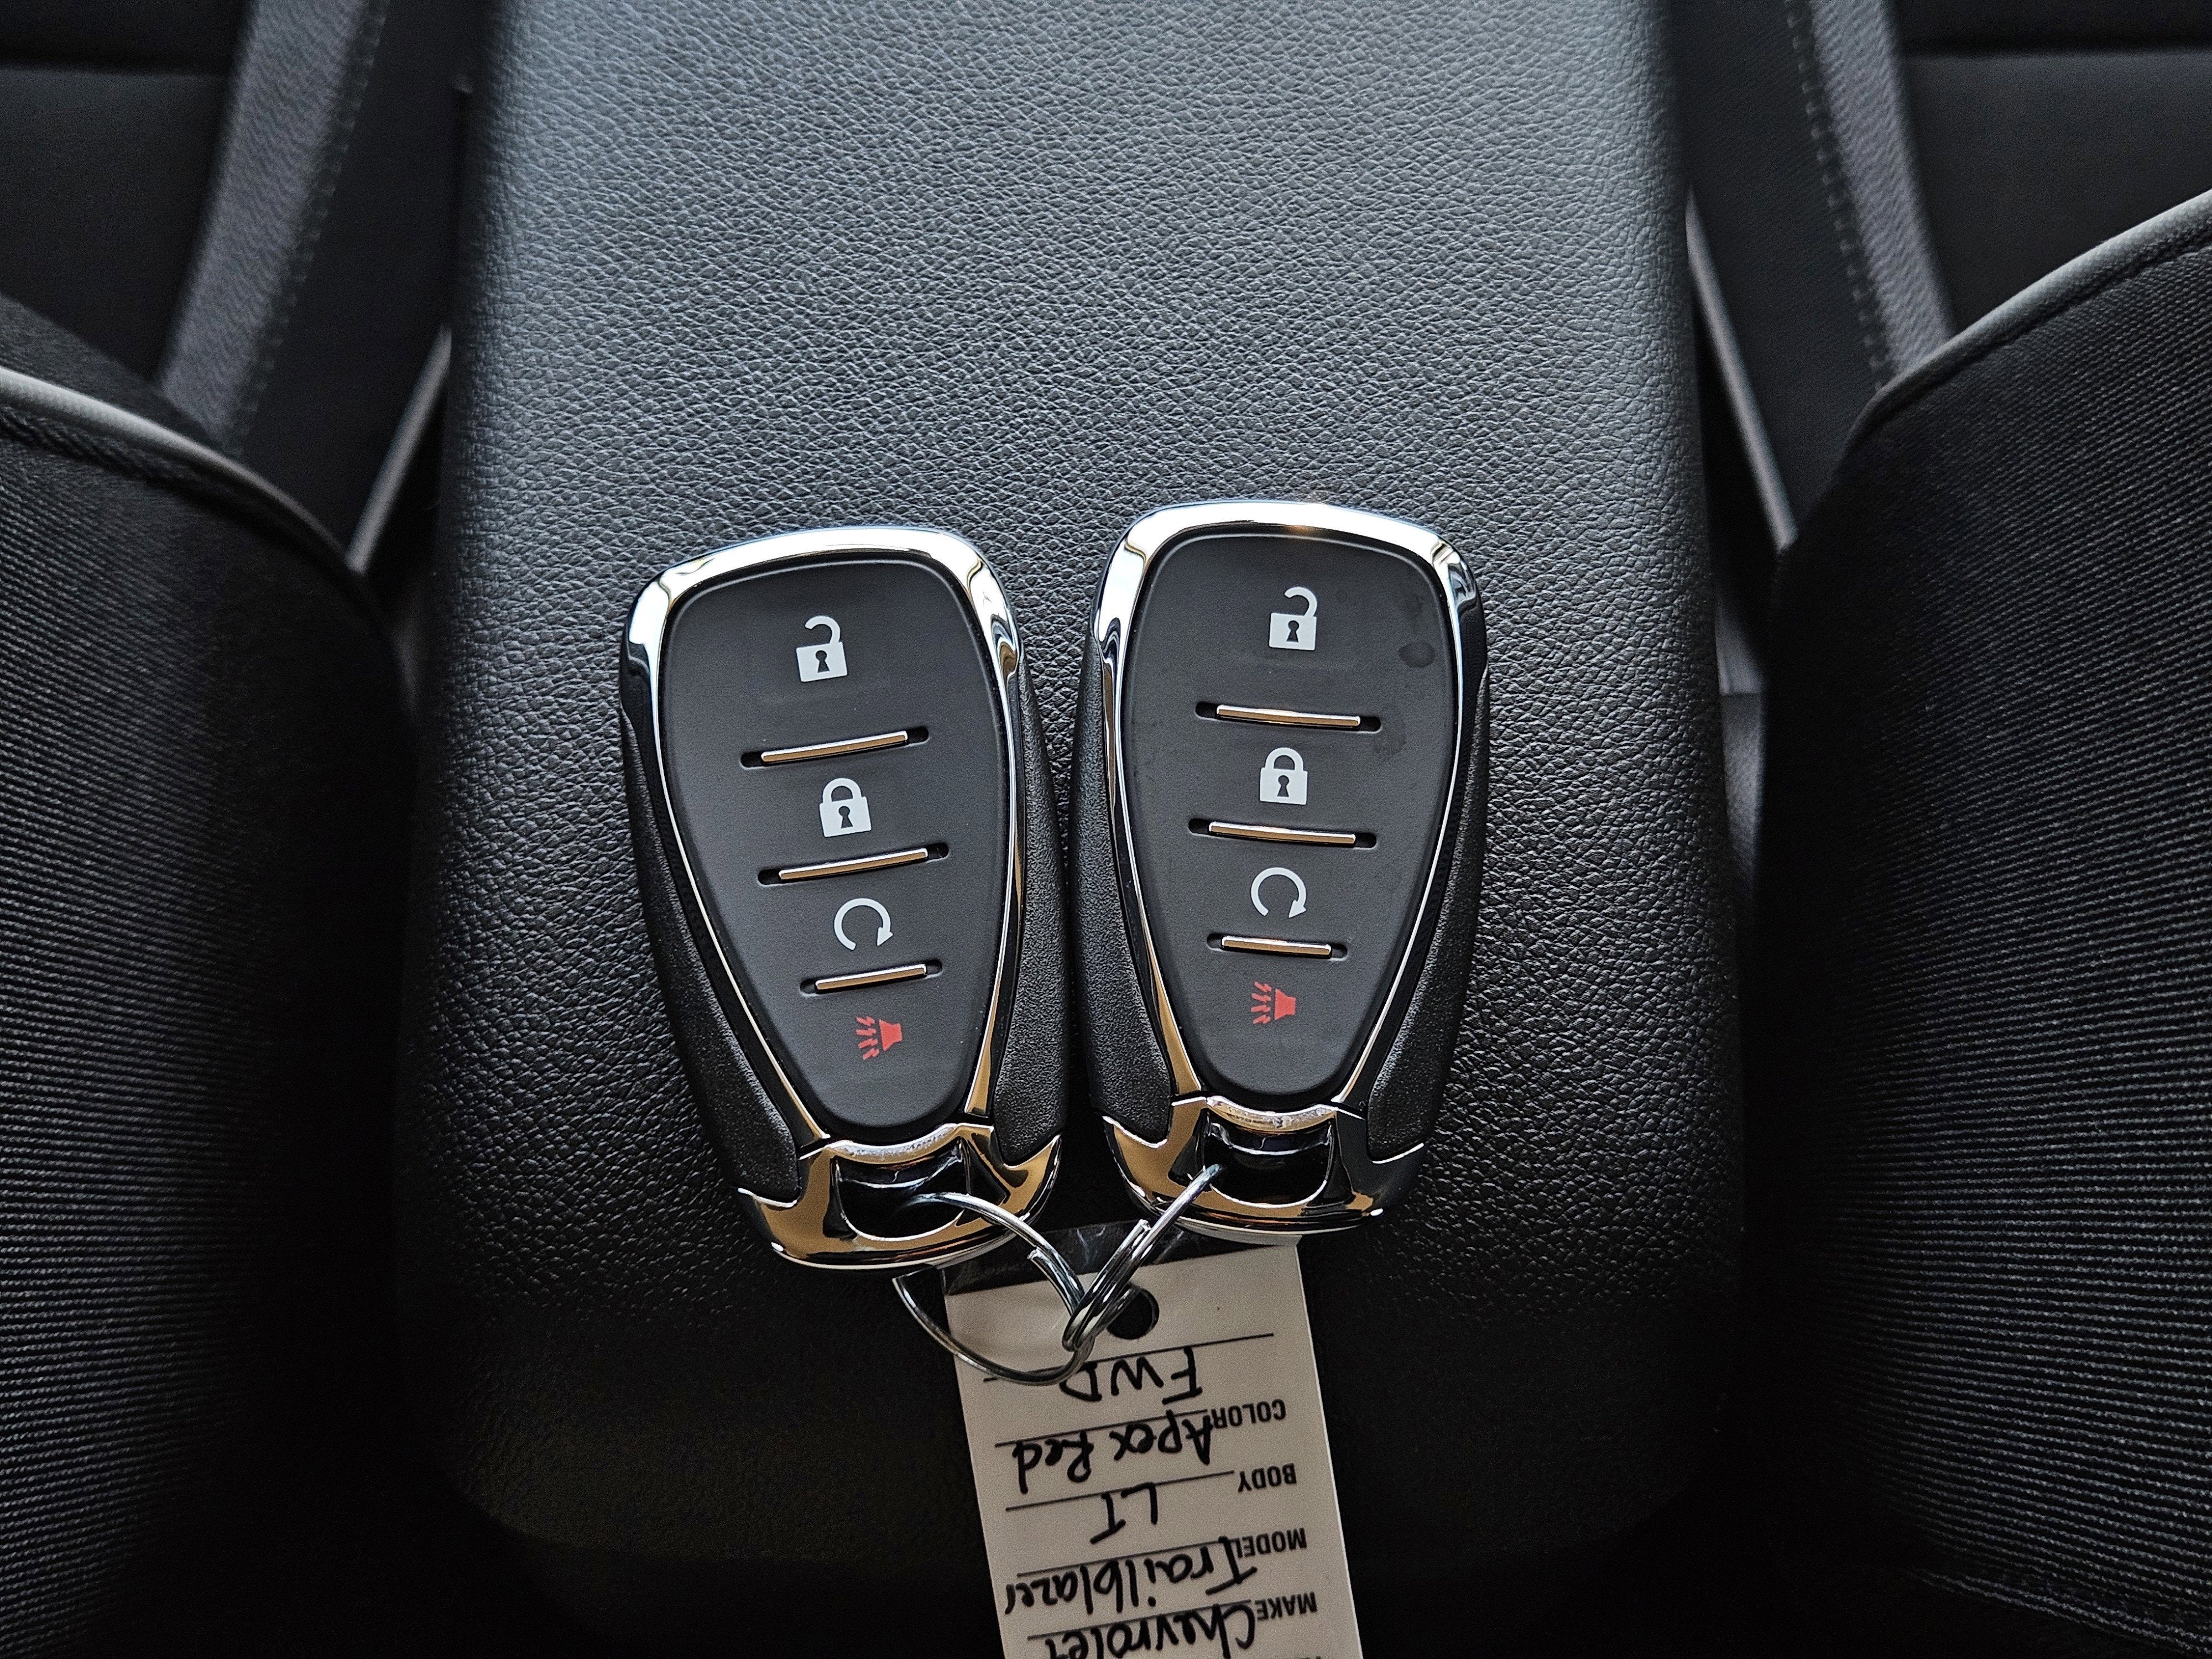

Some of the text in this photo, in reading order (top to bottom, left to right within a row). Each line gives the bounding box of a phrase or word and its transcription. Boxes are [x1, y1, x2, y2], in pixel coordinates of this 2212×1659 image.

[1058, 1347, 1203, 1406] FWD
[1211, 1399, 1286, 1430] COLOR
[1012, 1410, 1213, 1495] Apex Red
[1238, 1463, 1297, 1493] BODY
[1090, 1481, 1159, 1545] LT
[1230, 1528, 1307, 1559] MODEL
[1005, 1536, 1258, 1615] Trailblazer
[1255, 1592, 1317, 1621] MAKE
